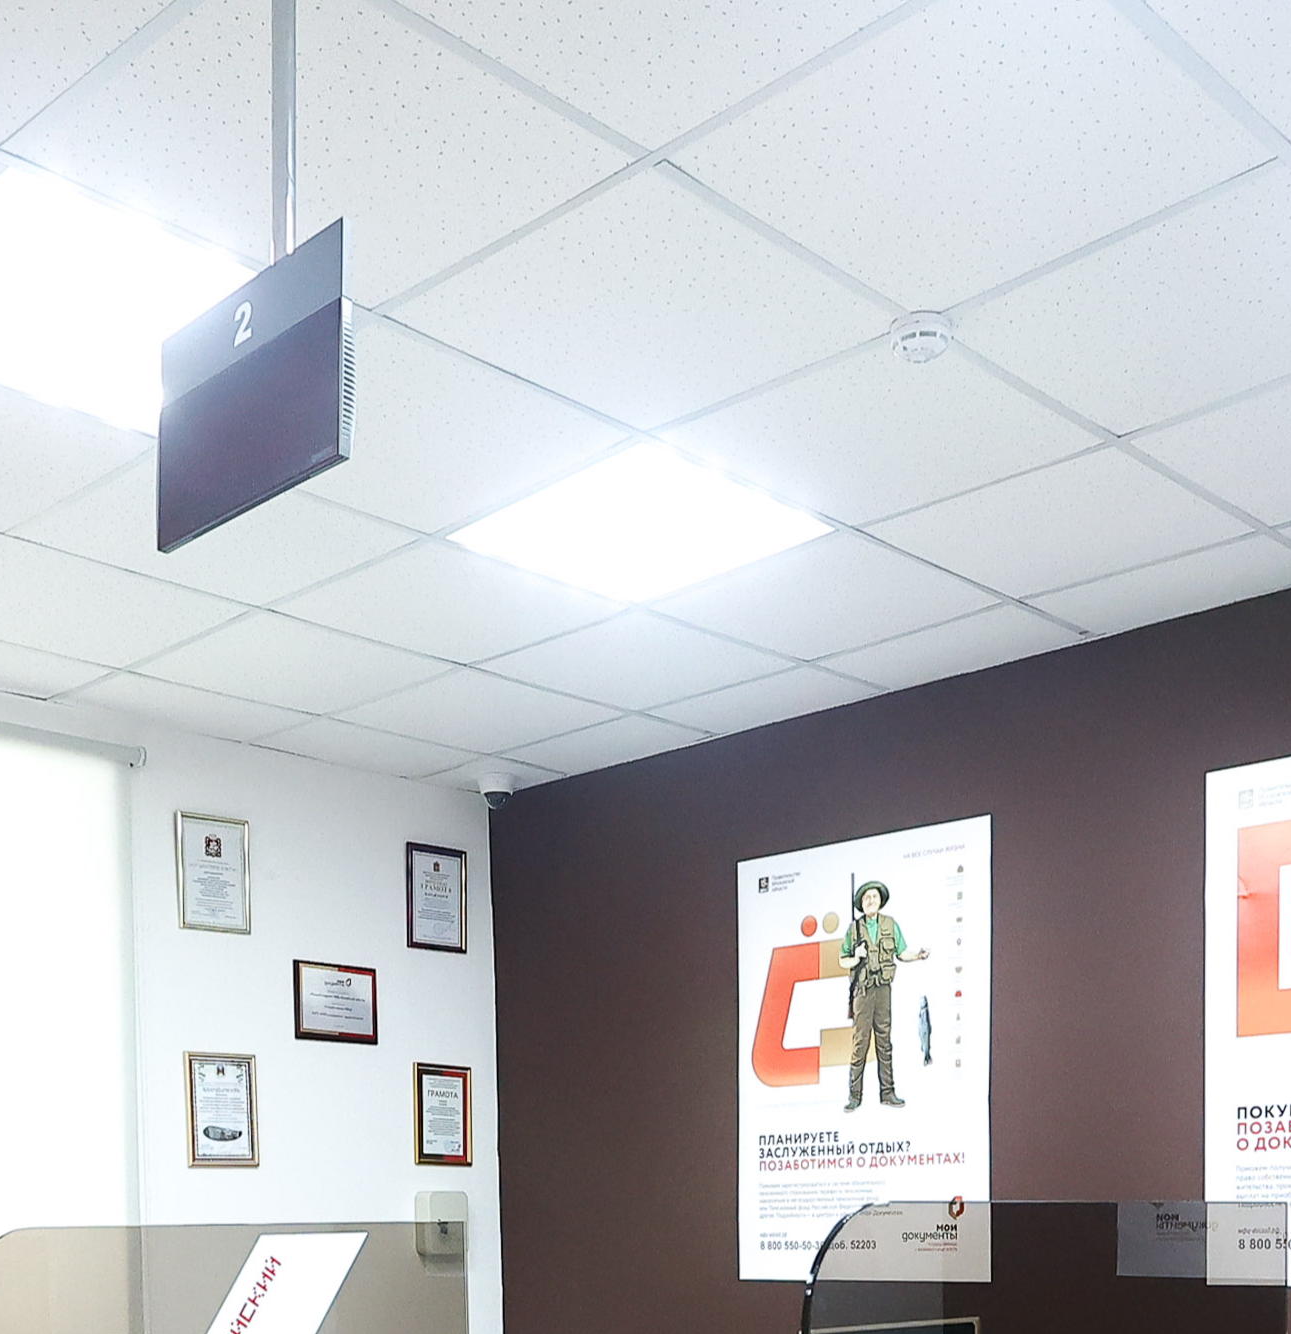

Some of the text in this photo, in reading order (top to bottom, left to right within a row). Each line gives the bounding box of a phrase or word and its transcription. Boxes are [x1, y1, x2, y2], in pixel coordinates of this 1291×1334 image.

[232, 302, 253, 348] 2
[428, 1090, 458, 1098] ГРАМОТА
[759, 1131, 839, 1146] ПЛАНИРУЕТЕ
[1236, 1137, 1249, 1151] О
[759, 1141, 911, 1159] ЗАСЛУЖЕННЫЙ ОТДЫХ?
[759, 1152, 965, 1172] ПОЗАБОТИМСЯ О ДОКУМЕНТАХ!
[901, 1230, 958, 1242] документы
[1238, 1239, 1245, 1250] 8
[1249, 1238, 1271, 1250] 800
